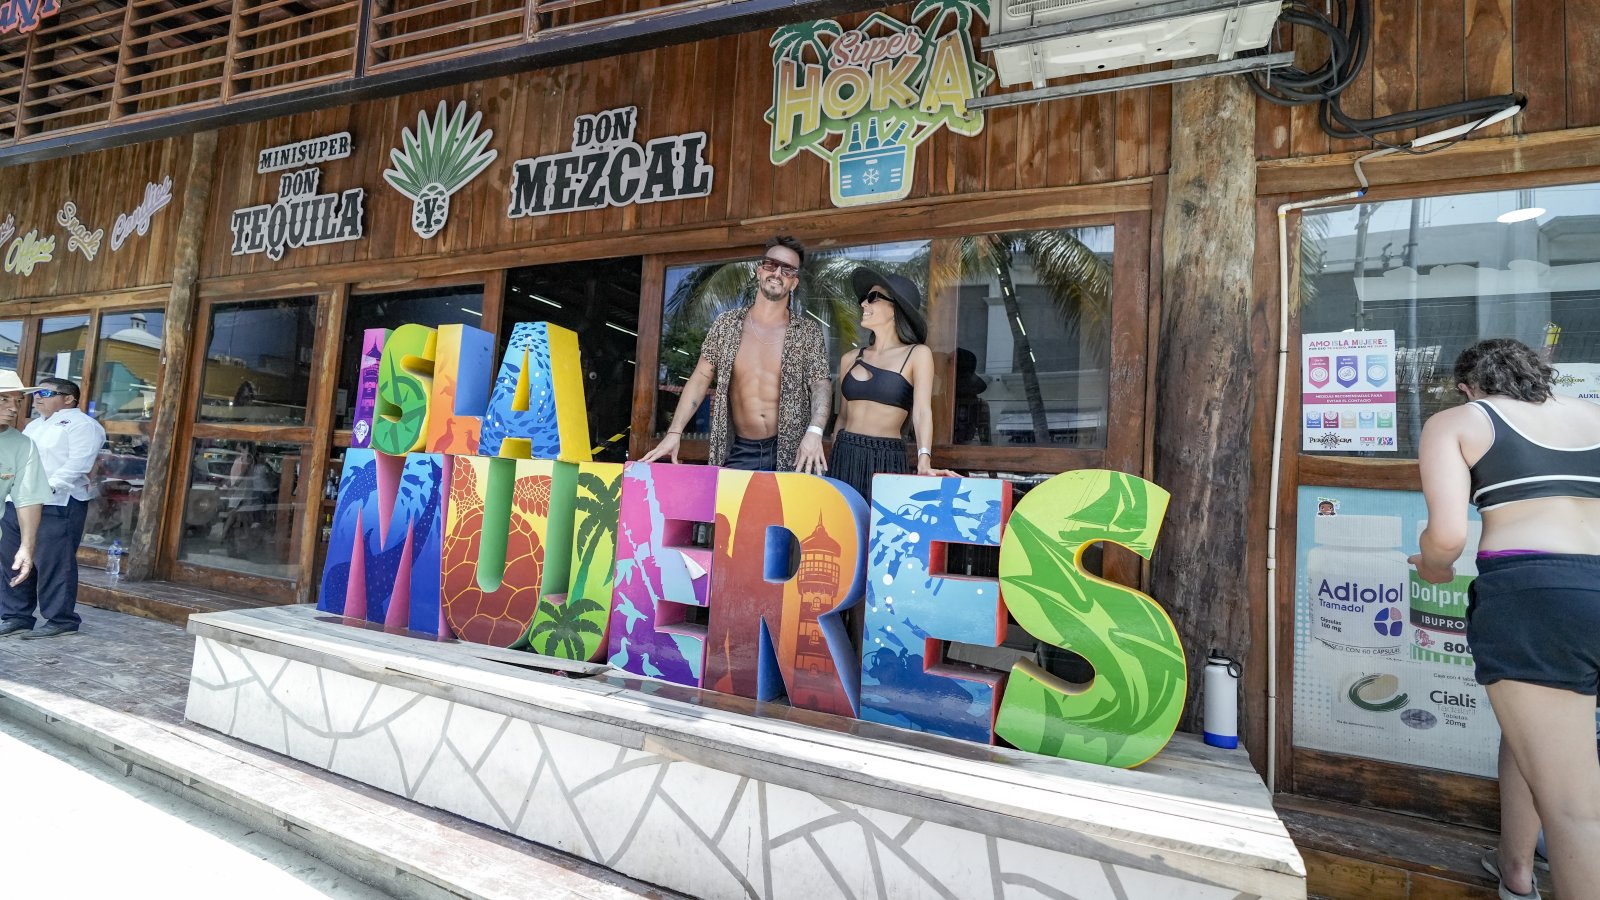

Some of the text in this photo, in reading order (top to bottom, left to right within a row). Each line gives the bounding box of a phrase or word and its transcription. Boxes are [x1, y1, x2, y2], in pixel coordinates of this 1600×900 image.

[828, 29, 921, 69] Super
[775, 30, 976, 151] HOKA
[576, 110, 633, 147] DON
[260, 136, 349, 170] MINISUPER
[280, 169, 318, 198] DON
[510, 136, 710, 216] MEZCAL
[57, 201, 104, 261] Snack
[233, 191, 361, 258] TEQUILA
[1309, 338, 1388, 348] AMO ISLA MUJERES
[351, 320, 592, 463] ISLA
[316, 446, 1188, 769] MUJERES
[1318, 579, 1403, 604] Adiolol
[1319, 598, 1364, 613] Tramadol
[1421, 615, 1465, 630] IBUPRO
[1345, 646, 1360, 654] CON
[1430, 690, 1476, 709] Cialis
[1445, 718, 1467, 729] 20mg
